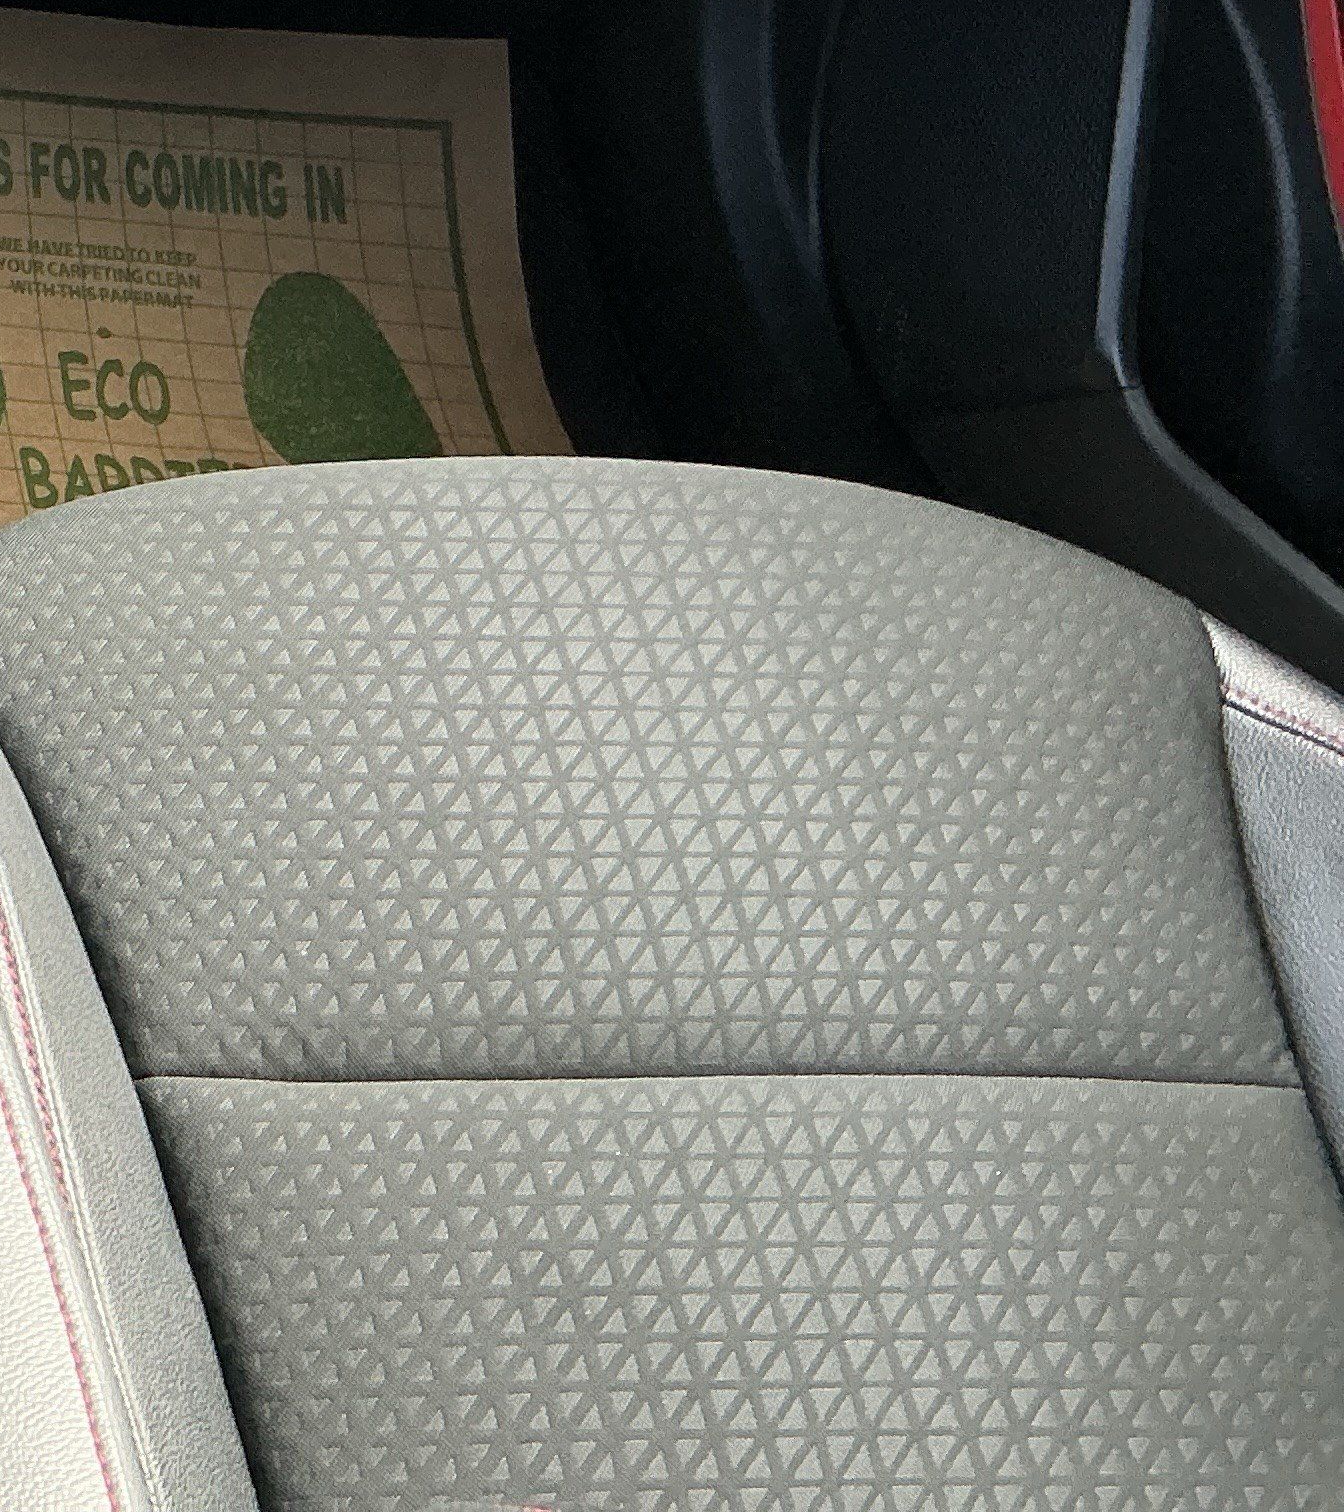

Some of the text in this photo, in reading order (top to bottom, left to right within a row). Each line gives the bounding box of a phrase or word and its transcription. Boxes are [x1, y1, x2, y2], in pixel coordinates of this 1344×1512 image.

[29, 141, 111, 205] FOR
[125, 150, 289, 221] COMING
[303, 163, 348, 224] IN
[28, 239, 72, 256] HAVE
[77, 243, 125, 261] TRIED
[127, 247, 151, 263] TO
[155, 249, 197, 266] KEEP
[47, 262, 142, 283] CARPETING
[146, 270, 202, 288] CLEAN
[10, 279, 56, 297] WITH
[57, 285, 97, 301] THIS
[58, 350, 170, 425] ECO
